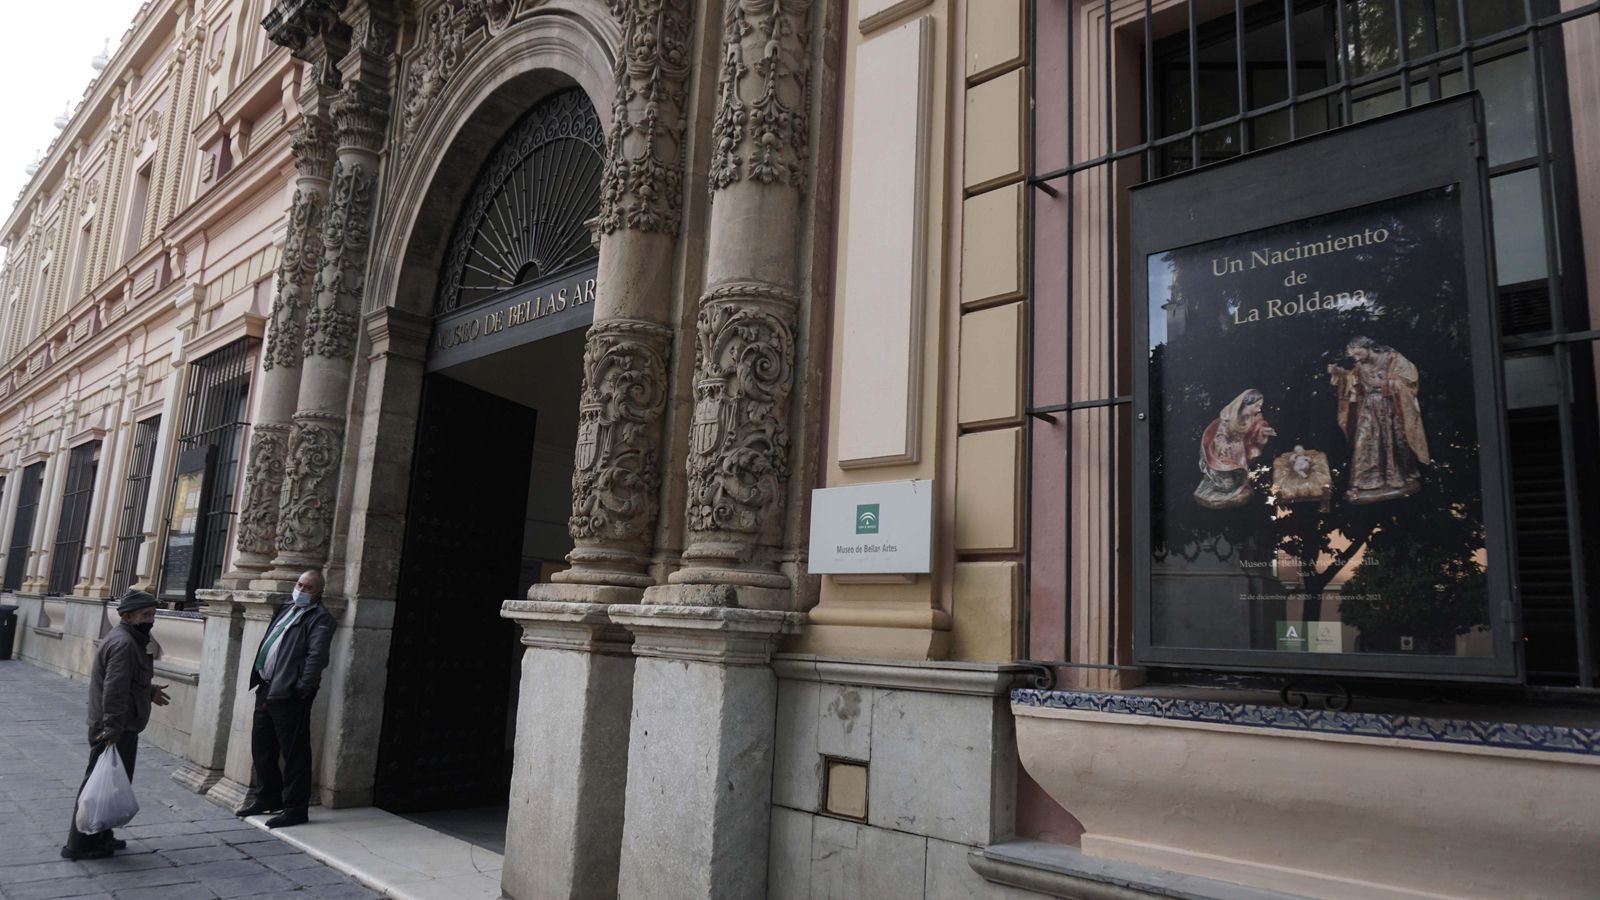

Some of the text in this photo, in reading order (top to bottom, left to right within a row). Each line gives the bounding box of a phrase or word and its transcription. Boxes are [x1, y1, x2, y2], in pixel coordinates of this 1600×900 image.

[1213, 227, 1390, 276] Un Nacimiento
[1284, 270, 1308, 287] de
[435, 319, 480, 351] MUSEO
[484, 311, 504, 337] DE
[508, 288, 568, 328] BELLAS
[1234, 289, 1366, 325] La Roldana
[836, 545, 854, 554] Museo
[855, 545, 862, 554] de
[882, 543, 898, 553] Artes
[1239, 560, 1267, 568] Museo
[1348, 557, 1380, 567] villa
